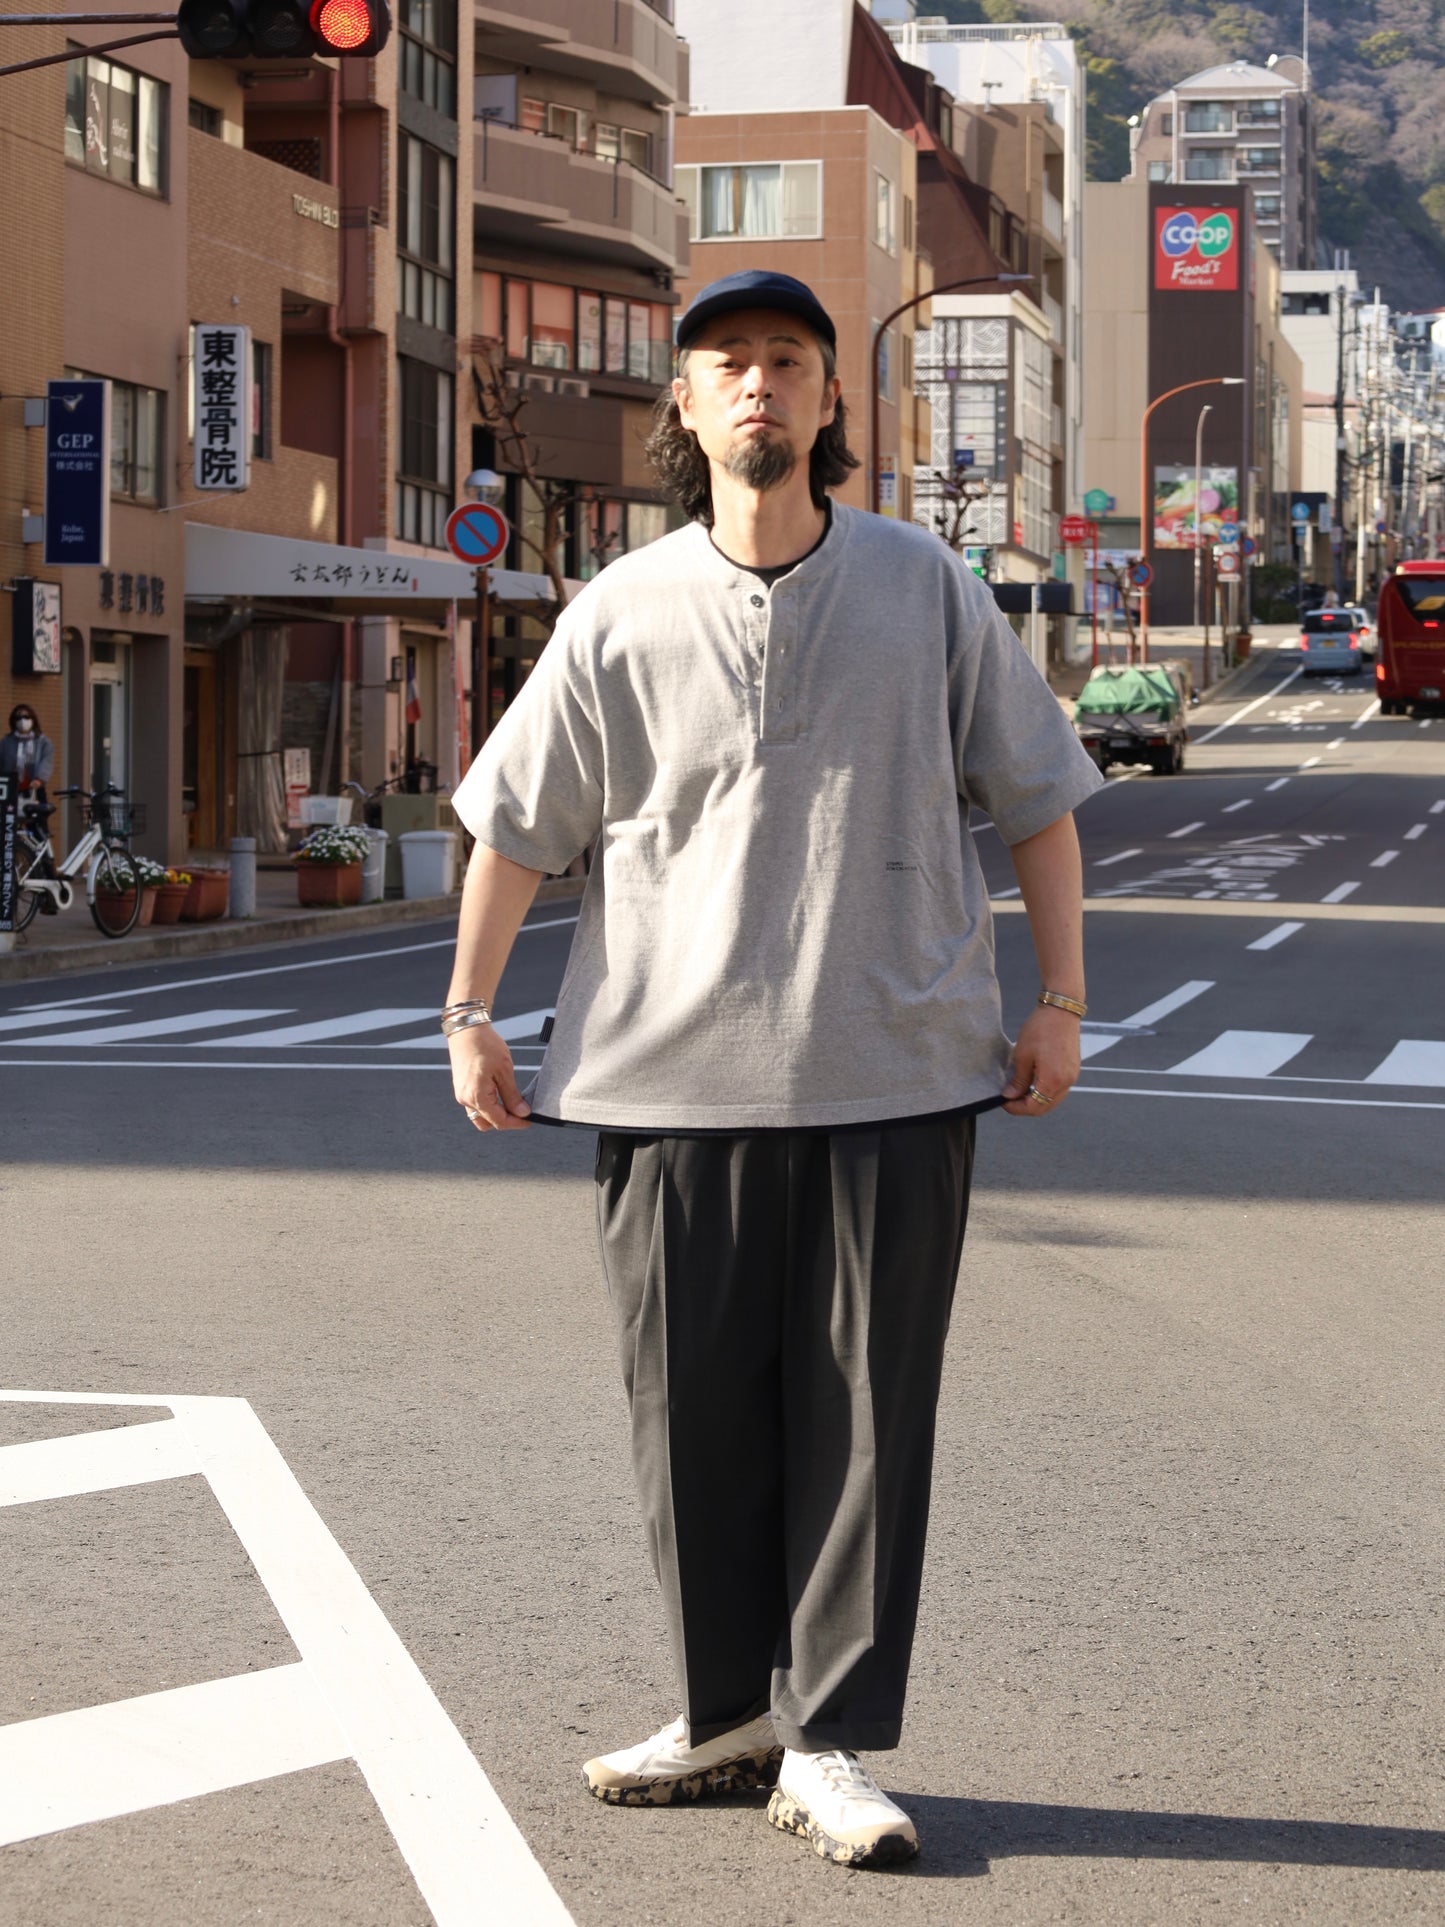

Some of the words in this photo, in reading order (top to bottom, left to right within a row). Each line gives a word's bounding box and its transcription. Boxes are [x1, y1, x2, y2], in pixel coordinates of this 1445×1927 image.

[57, 433, 94, 449] GEP
[201, 331, 237, 485] 東整骨院
